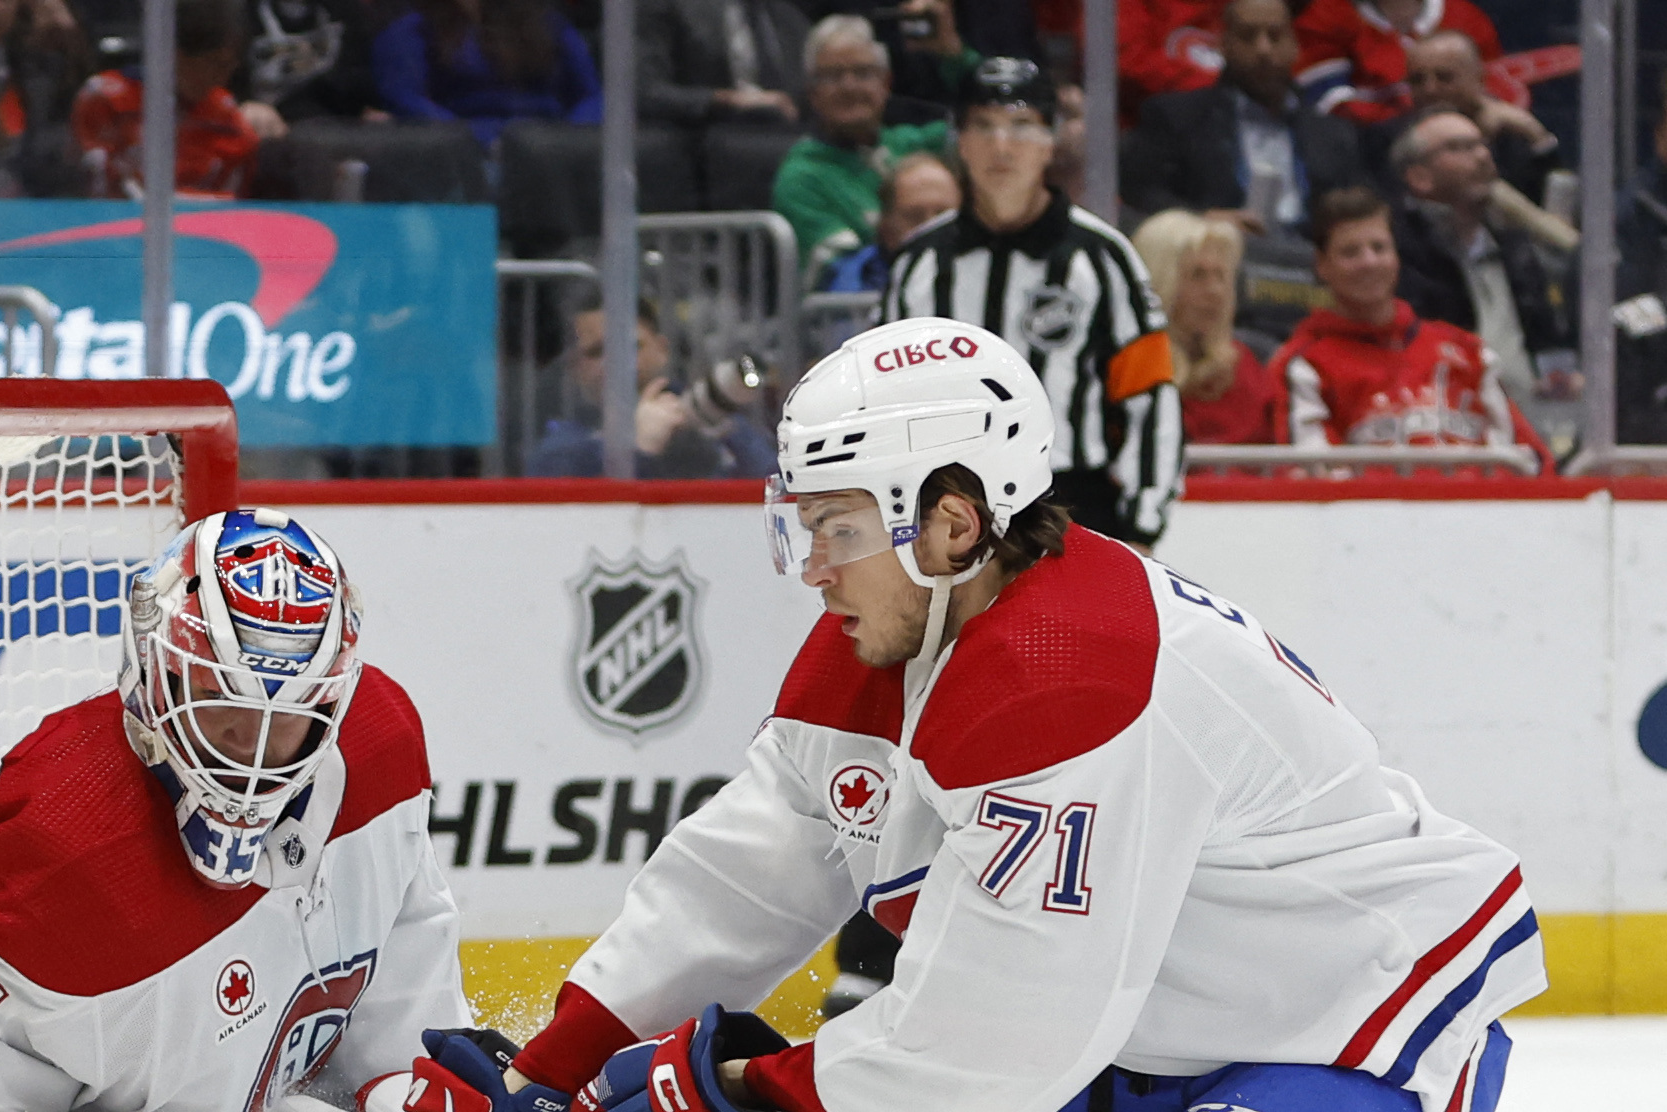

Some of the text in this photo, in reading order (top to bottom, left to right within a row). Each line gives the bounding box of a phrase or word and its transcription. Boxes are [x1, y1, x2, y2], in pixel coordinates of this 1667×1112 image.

[874, 339, 947, 372] CIBC
[237, 651, 311, 674] CCM
[597, 602, 678, 702] NHL
[195, 818, 273, 883] 35
[977, 790, 1098, 915] 71
[218, 1001, 267, 1042] AIR CANADA
[534, 1096, 567, 1112] CCM
